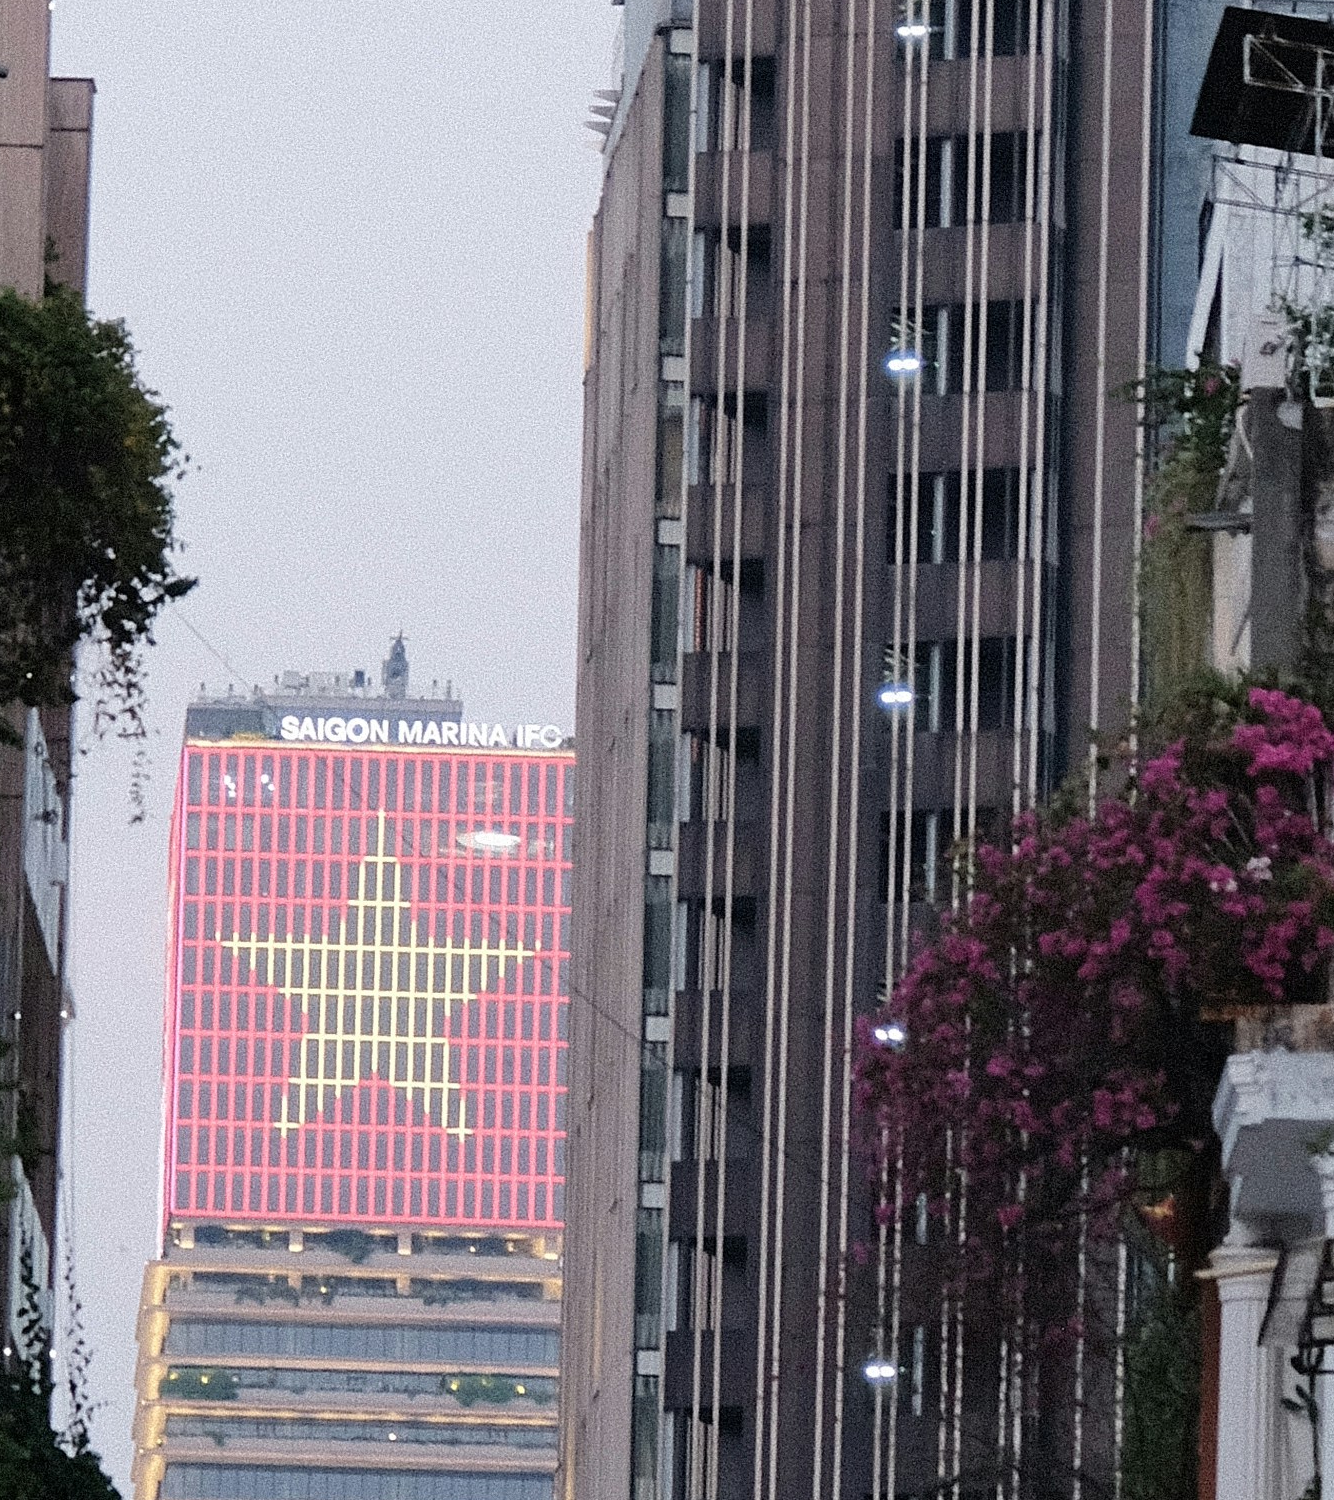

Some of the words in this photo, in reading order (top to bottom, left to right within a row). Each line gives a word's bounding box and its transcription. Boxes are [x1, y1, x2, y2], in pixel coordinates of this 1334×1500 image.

[280, 715, 389, 742] SAIGON
[398, 720, 507, 746] MARINA
[516, 724, 563, 749] IFC
